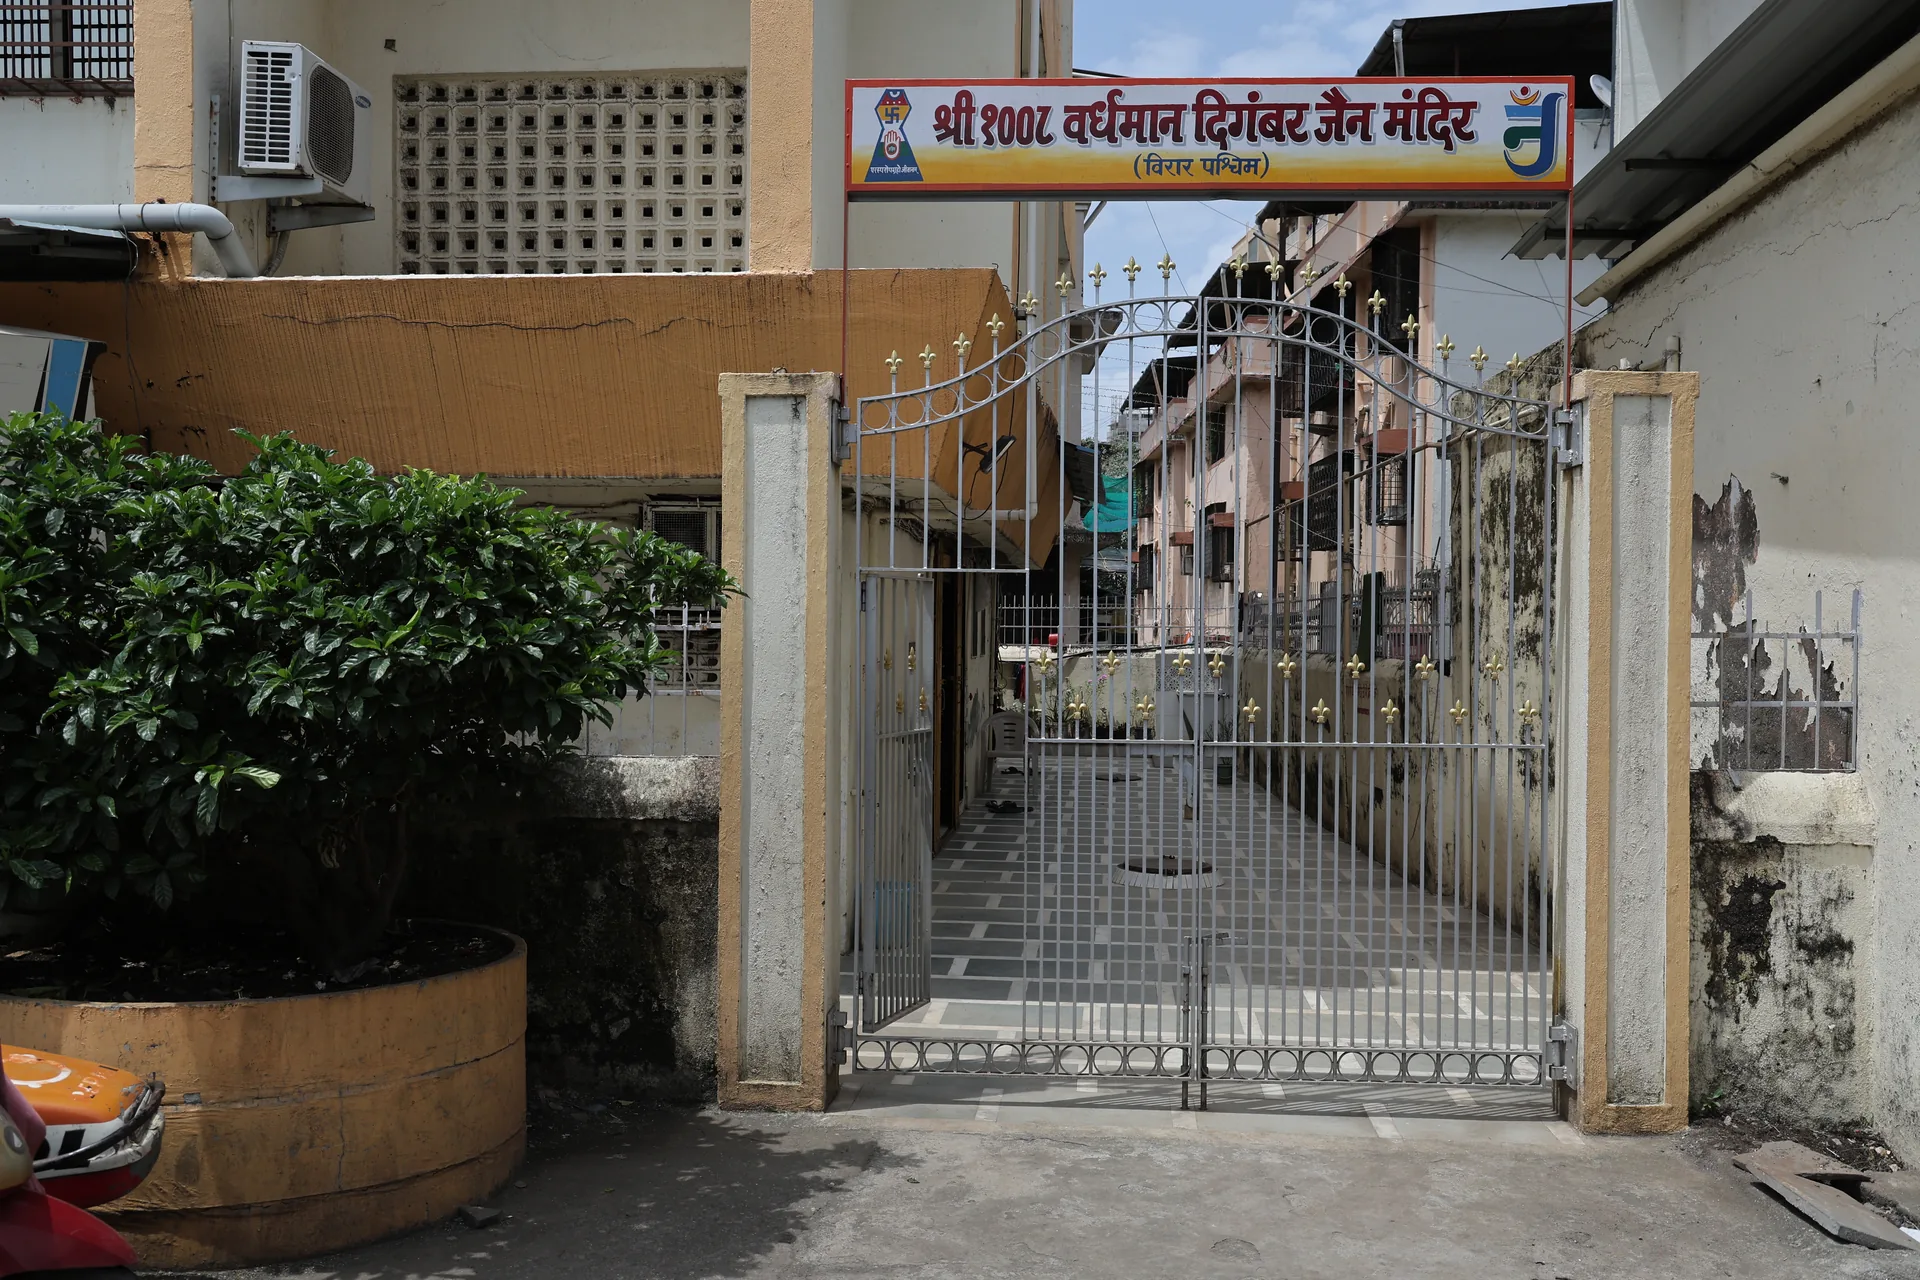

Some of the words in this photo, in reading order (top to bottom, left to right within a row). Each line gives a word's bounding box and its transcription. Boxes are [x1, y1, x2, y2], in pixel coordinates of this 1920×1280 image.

[1063, 88, 1188, 145] वर्धमान
[1192, 88, 1310, 151] दिगंबर
[1314, 86, 1377, 143] जैन
[1384, 87, 1478, 152] मंदिर
[1133, 152, 1194, 179] (विरार
[1199, 151, 1270, 179] पश्चिम)
